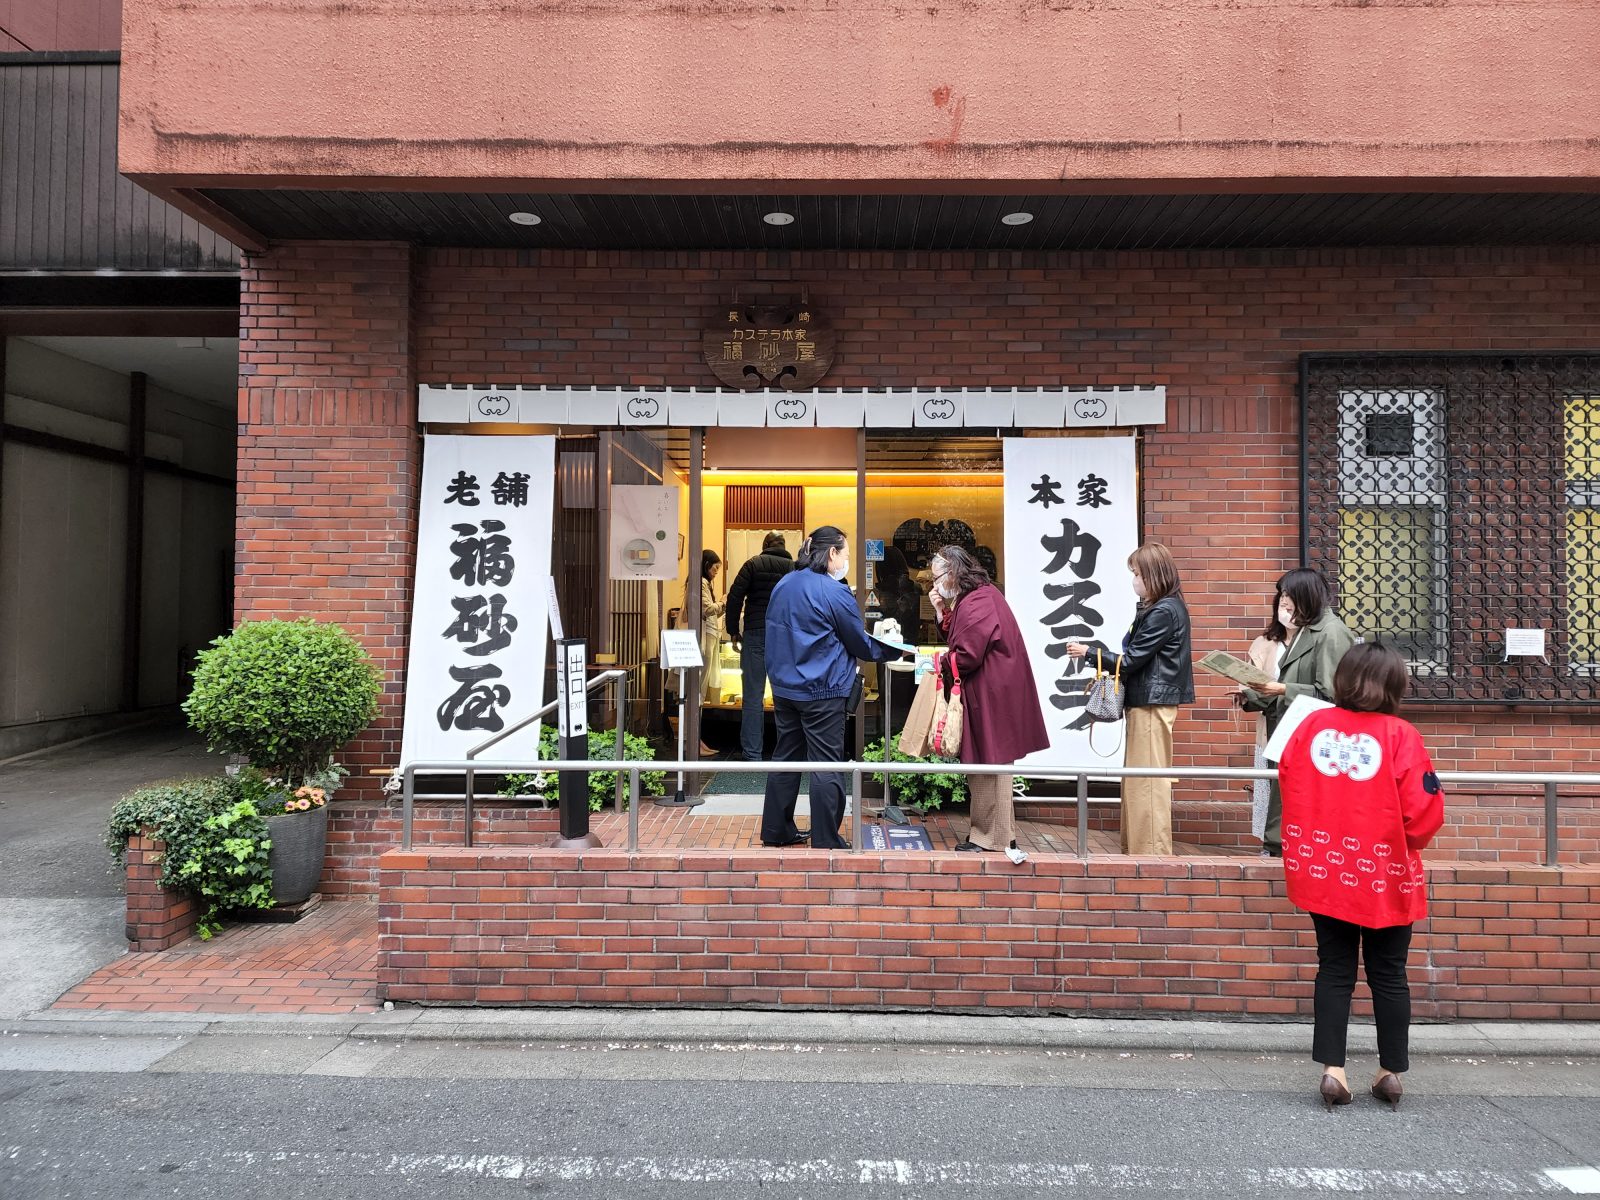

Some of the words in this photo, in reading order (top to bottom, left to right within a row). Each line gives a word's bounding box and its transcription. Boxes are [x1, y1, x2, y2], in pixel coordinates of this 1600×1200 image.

[723, 341, 816, 361] 福砂屋
[732, 328, 807, 342] カステラ本家
[443, 470, 531, 508] 老舗
[1027, 472, 1113, 509] 本家
[436, 519, 519, 733] 福砂屋
[570, 653, 583, 695] 出口
[570, 701, 584, 710] EXIT
